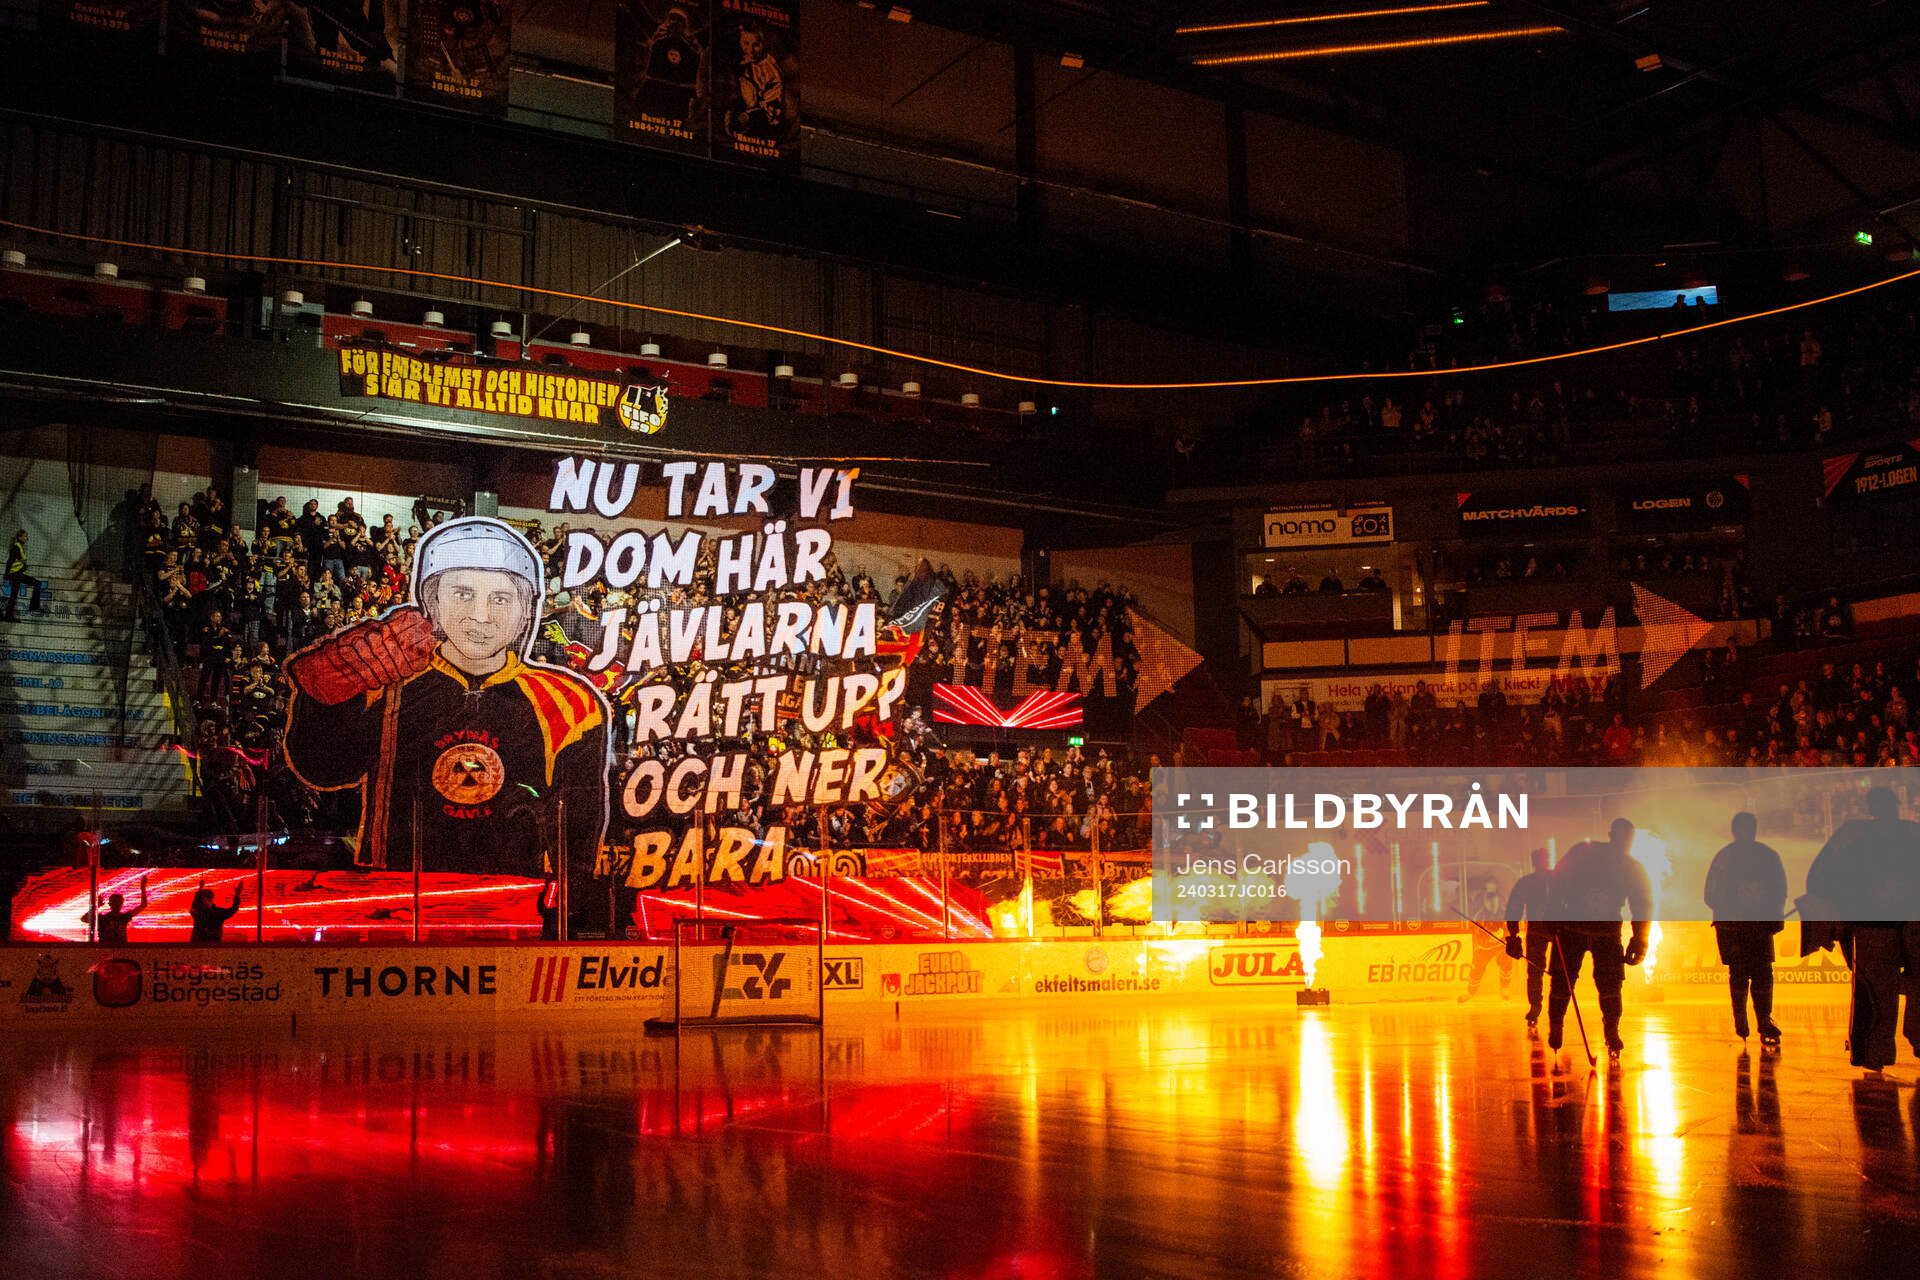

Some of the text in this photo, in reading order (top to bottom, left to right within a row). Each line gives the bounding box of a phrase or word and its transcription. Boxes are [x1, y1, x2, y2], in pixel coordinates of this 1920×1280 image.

[341, 349, 620, 408] FÖR EMBLEMET OCH HISTORIEN
[366, 370, 599, 424] STÅR VI ALLTID KVAR
[622, 404, 661, 427] TIFO
[549, 456, 861, 520] NU TAR VI
[1632, 497, 1692, 511] LOGEN
[1269, 519, 1336, 535] nomo
[563, 520, 832, 596] DOM HÄR
[588, 598, 876, 672] JÄVLARNA
[1444, 606, 1622, 687] ITEM
[1328, 683, 1361, 697] Hela
[1365, 681, 1422, 696] vckan
[1458, 678, 1477, 695] på
[1504, 677, 1540, 690] klick!
[636, 670, 788, 744] RÄTT
[801, 665, 907, 733] UPP
[623, 747, 887, 818] OCH NER
[624, 826, 787, 889] BARA
[153, 961, 264, 985] Höganäs
[577, 956, 670, 989] Elvid
[824, 962, 860, 985] XL
[919, 951, 965, 973] EURO
[1213, 952, 1307, 977] JULA
[314, 964, 497, 997] THORNE
[904, 971, 982, 995] JACKPOT
[1685, 972, 1730, 983] PERFOR
[1778, 971, 1822, 983] POWER
[1824, 971, 1853, 983] TOO
[153, 981, 281, 1006] Borgestad
